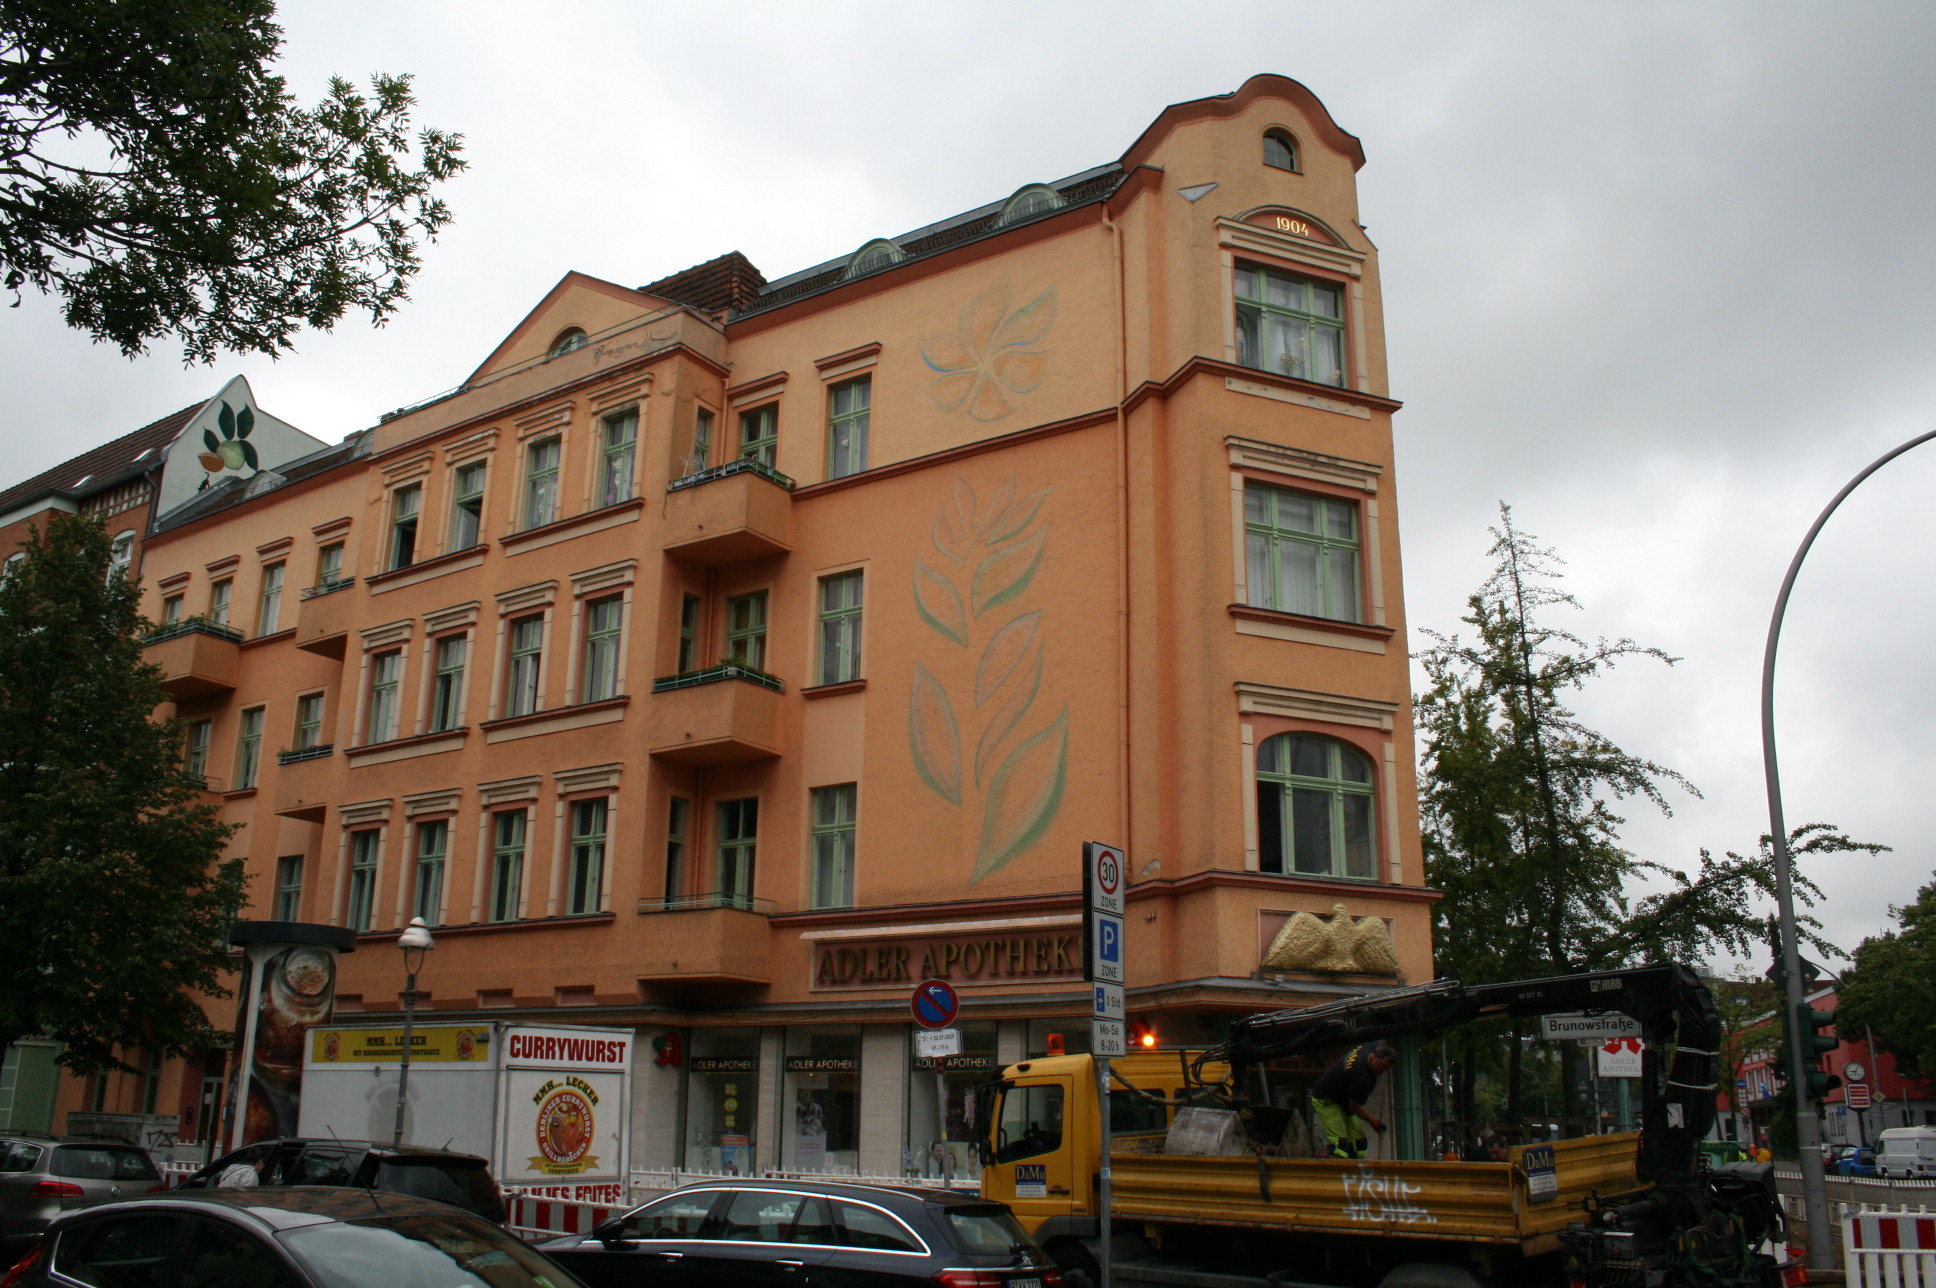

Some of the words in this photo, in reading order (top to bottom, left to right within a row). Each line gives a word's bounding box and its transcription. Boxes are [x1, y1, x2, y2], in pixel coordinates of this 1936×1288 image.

[1276, 216, 1310, 237] 1904
[1102, 861, 1115, 883] 30
[1100, 895, 1117, 910] ZONE
[1104, 925, 1114, 955] P
[819, 944, 911, 982] ADLER
[921, 935, 1084, 979] APOTHEK
[1101, 964, 1117, 978] ZONE
[1601, 978, 1622, 991] HIAB
[1106, 995, 1110, 1006] 3
[1111, 996, 1122, 1009] Std.
[1100, 1023, 1119, 1036] Mo-Sa
[1549, 1017, 1634, 1032] Brunowstraße
[395, 1035, 427, 1046] LEKER
[1101, 1040, 1114, 1051] 8-20
[1115, 1041, 1119, 1052] h
[509, 1034, 627, 1063] CURRYWURST
[693, 1060, 717, 1070] ADLER
[718, 1060, 758, 1070] APOTHEKE
[788, 1060, 814, 1069] ADLER
[816, 1060, 859, 1069] APOTHEKE
[915, 1058, 936, 1068] ADL
[946, 1058, 994, 1068] APOTHEKE
[1609, 1057, 1637, 1065] ADLER
[532, 1080, 564, 1106] MMH...
[565, 1075, 599, 1106] LECKER
[540, 1096, 561, 1138] BERLINER
[562, 1094, 591, 1138] CURRYWURST
[1526, 1150, 1554, 1170] DaMu
[1016, 1165, 1045, 1180] DaMu
[575, 1184, 621, 1204] FRITES
